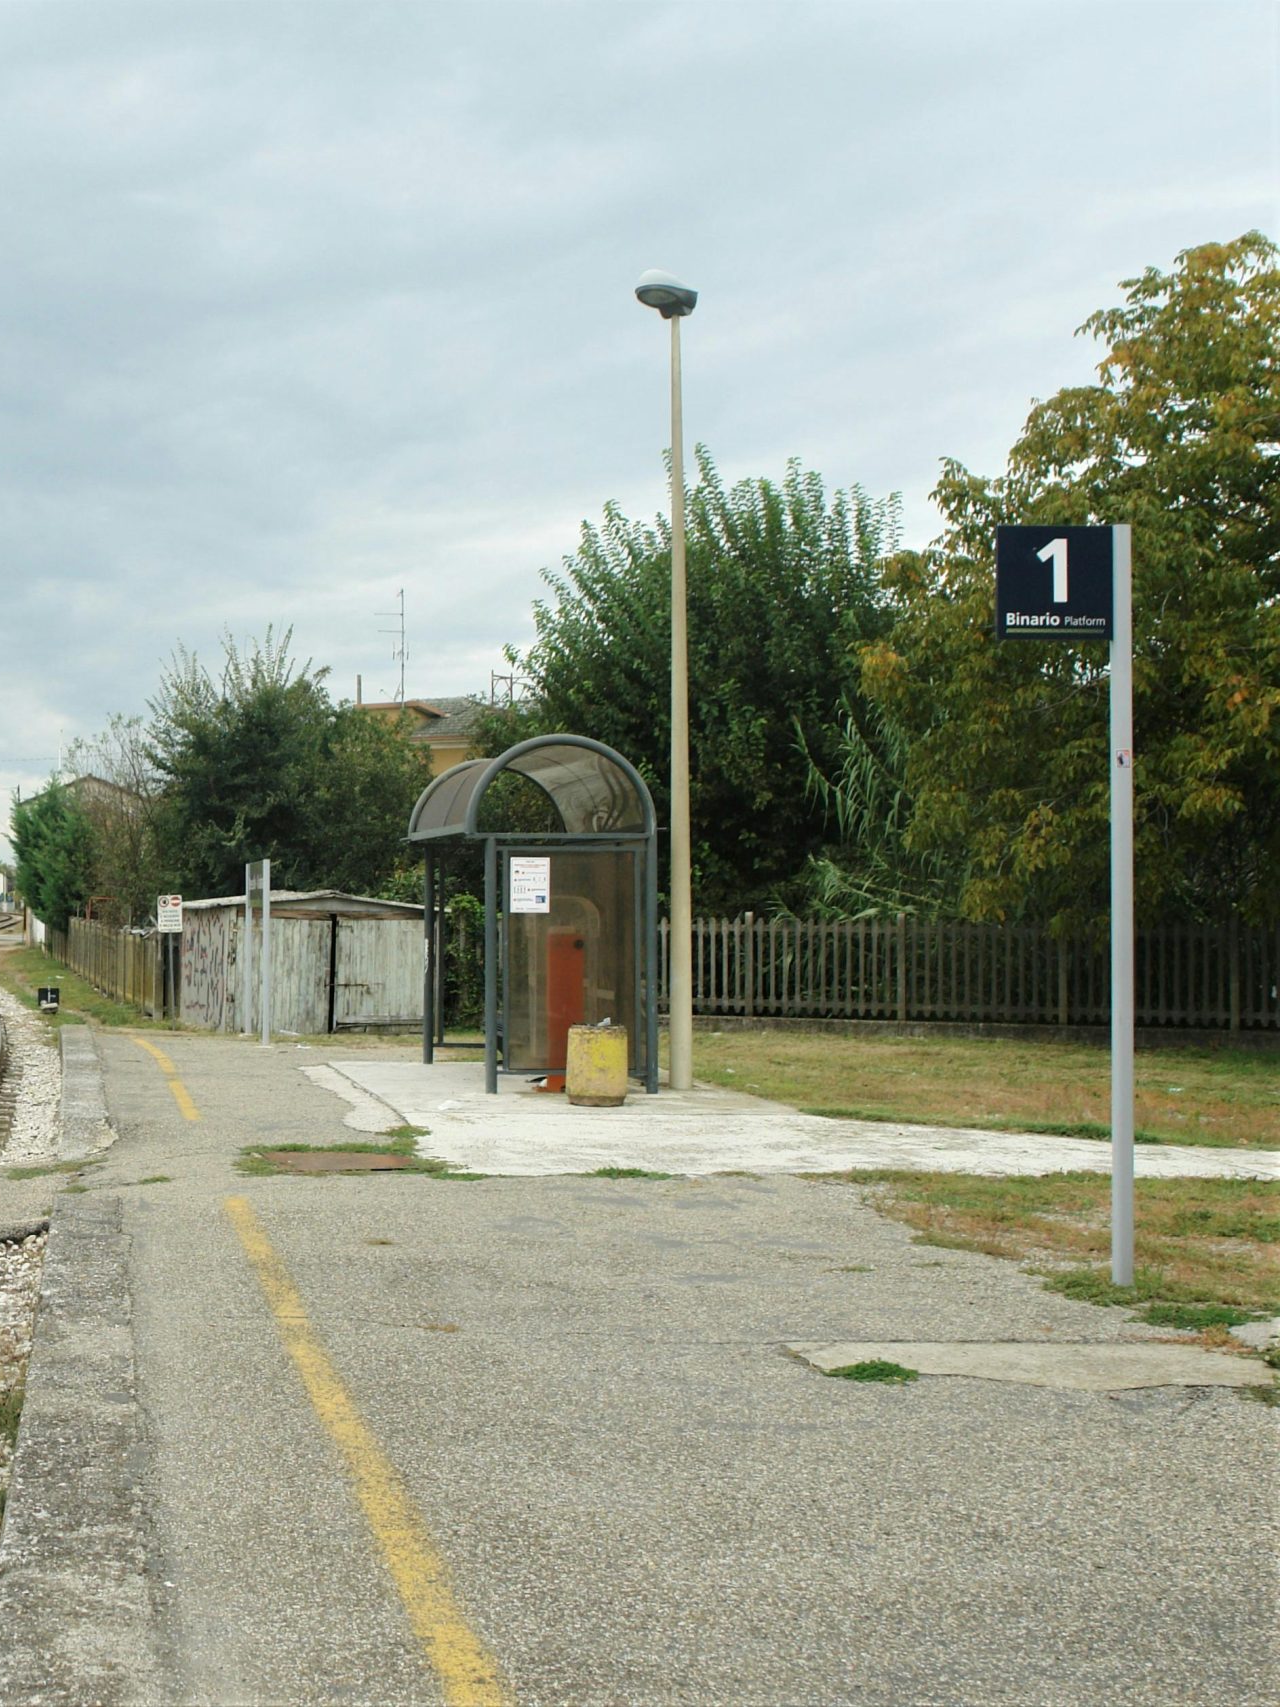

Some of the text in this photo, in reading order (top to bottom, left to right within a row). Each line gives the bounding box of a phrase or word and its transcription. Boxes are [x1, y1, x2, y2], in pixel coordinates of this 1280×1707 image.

[1036, 538, 1068, 603] 1
[1006, 612, 1106, 627] Binario Platform
